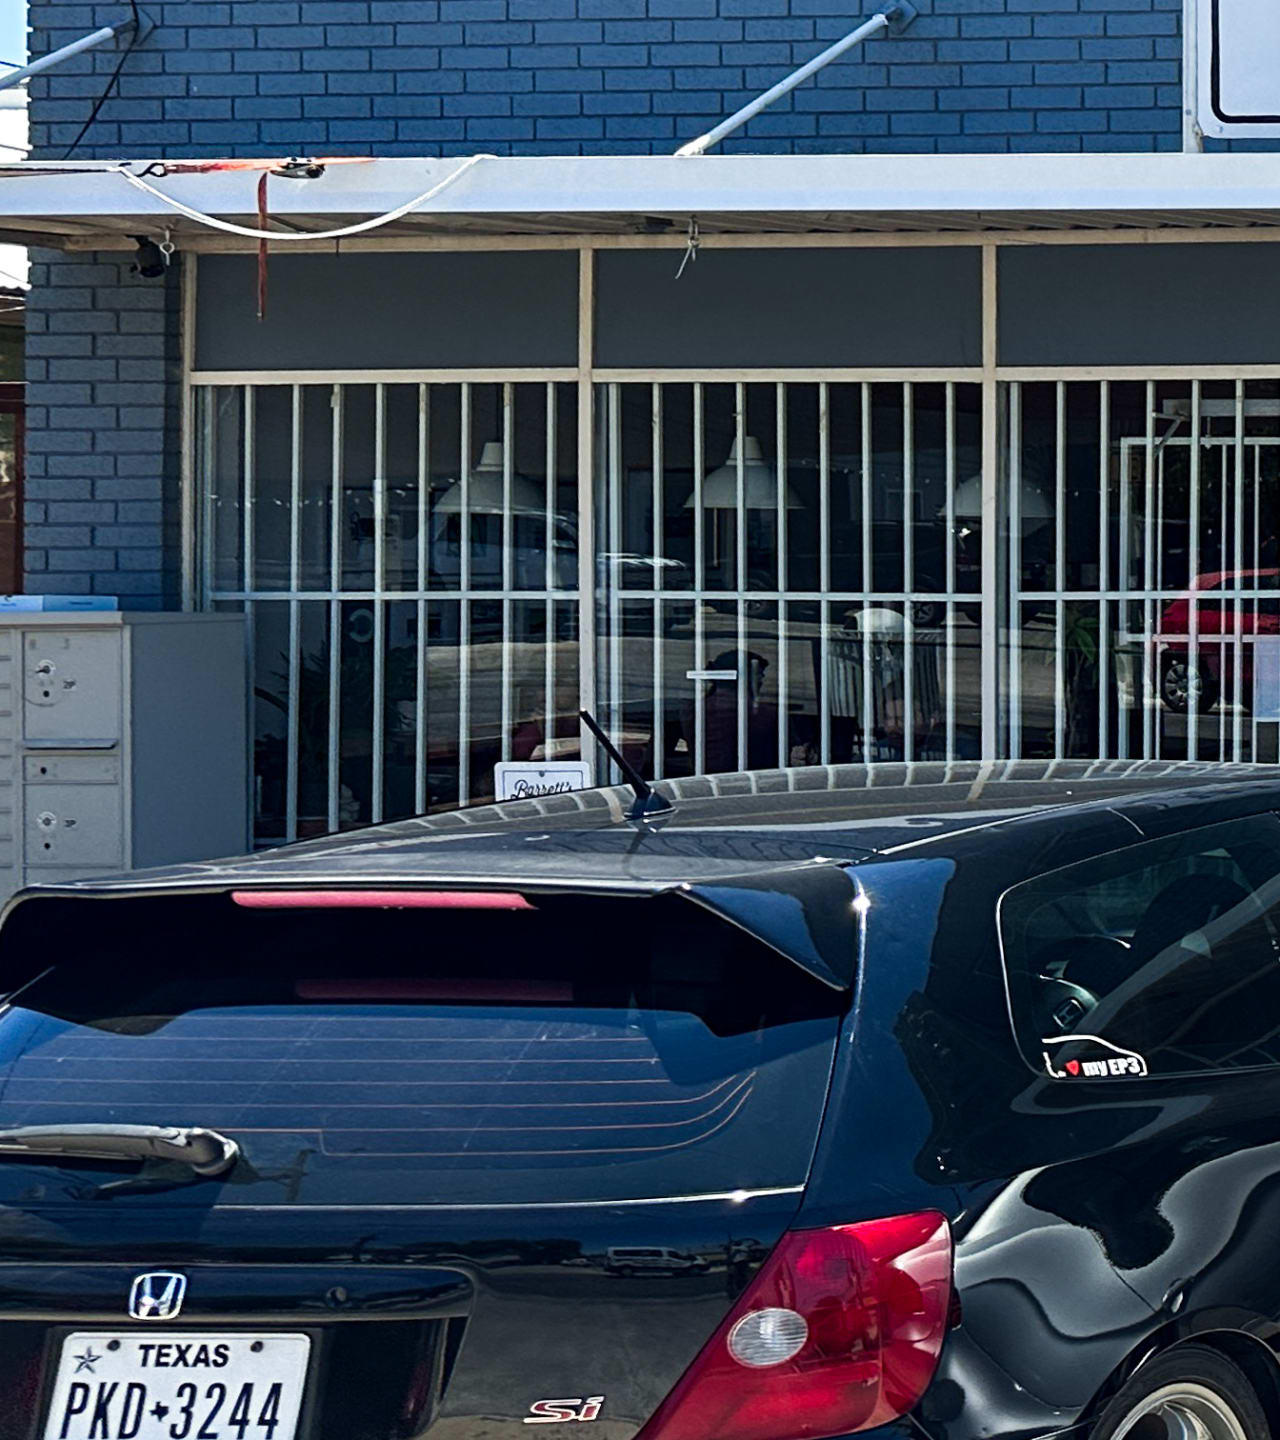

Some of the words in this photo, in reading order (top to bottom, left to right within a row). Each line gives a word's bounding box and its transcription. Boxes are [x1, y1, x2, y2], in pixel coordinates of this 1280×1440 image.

[1108, 1057, 1140, 1075] EP3
[138, 1343, 231, 1369] TEXAS
[523, 1395, 607, 1424] Si
